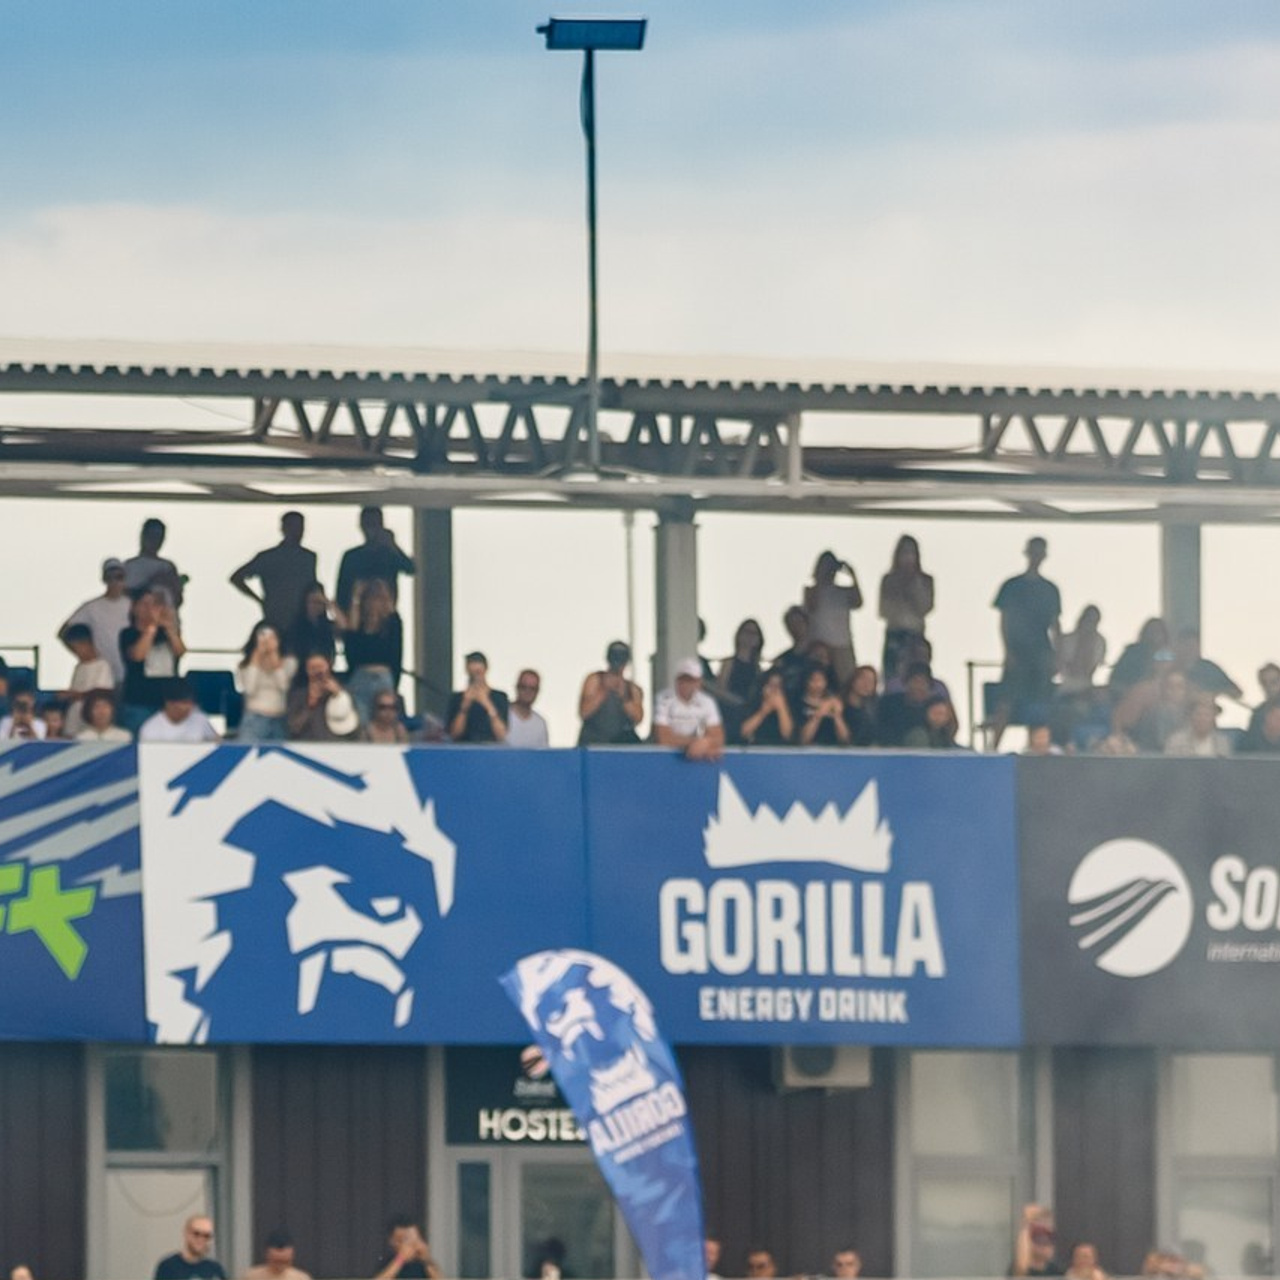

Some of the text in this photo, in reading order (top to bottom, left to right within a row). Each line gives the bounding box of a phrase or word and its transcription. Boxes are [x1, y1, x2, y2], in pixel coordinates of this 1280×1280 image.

[658, 878, 946, 978] GORILLA
[1205, 854, 1280, 932] So
[699, 987, 909, 1023] ENERGY DRINK
